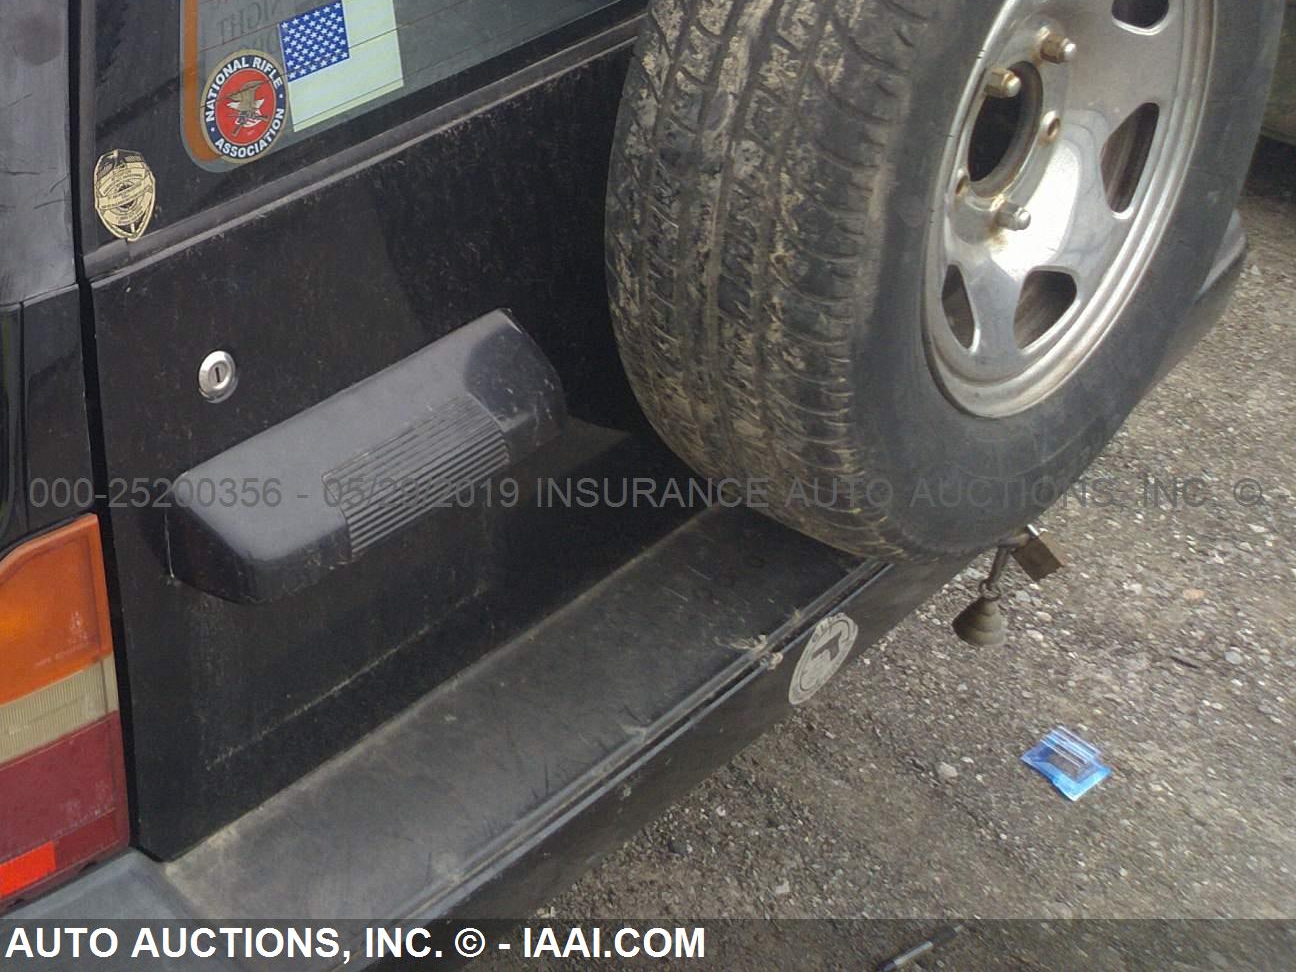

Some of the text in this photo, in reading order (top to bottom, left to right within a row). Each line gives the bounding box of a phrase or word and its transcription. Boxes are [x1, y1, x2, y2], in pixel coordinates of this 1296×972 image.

[204, 56, 284, 123] NATIONAL RIFLE
[215, 108, 285, 158] ASSOCIATION
